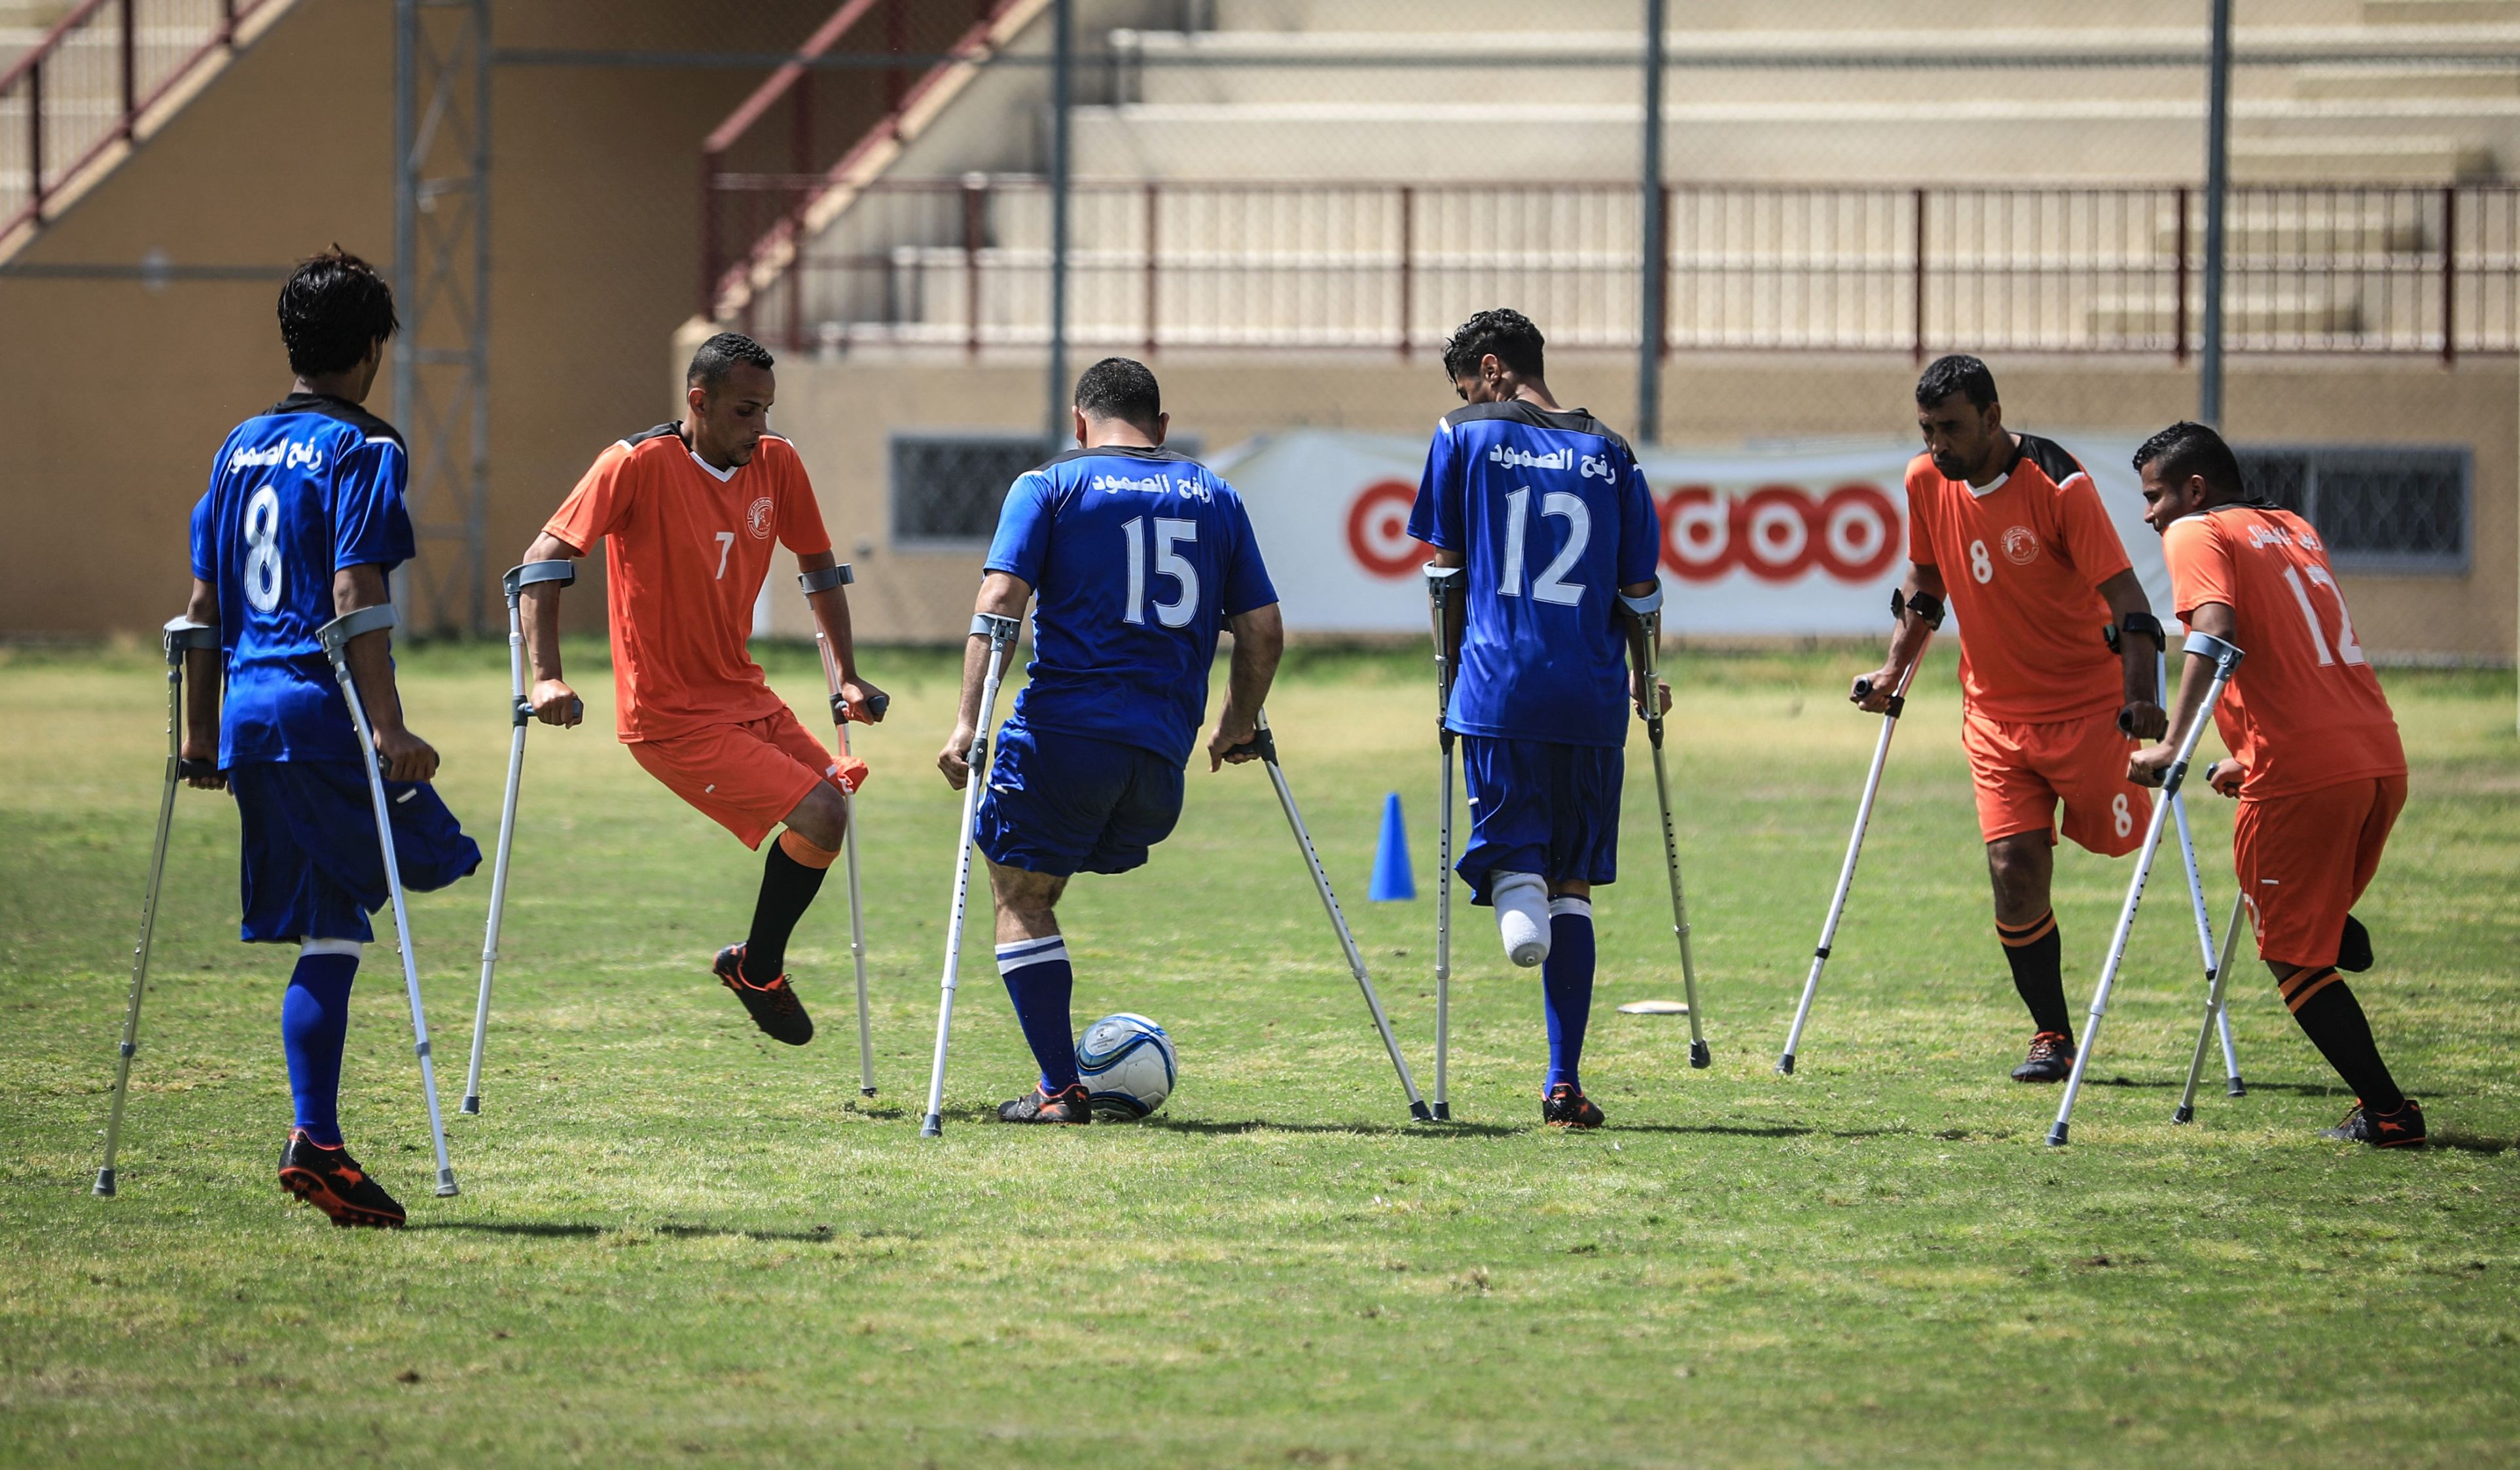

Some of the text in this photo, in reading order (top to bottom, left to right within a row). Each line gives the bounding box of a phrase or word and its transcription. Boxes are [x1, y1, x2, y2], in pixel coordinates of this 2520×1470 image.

[227, 436, 323, 475] رفح الصمو
[1489, 444, 1617, 485] رفح الصمود
[1092, 473, 1211, 503] رفح الصمود
[244, 485, 282, 613] 8
[715, 531, 735, 581] 7
[1497, 486, 1592, 607] 12
[1970, 539, 1993, 584] 8
[1121, 516, 1200, 628] 15
[2283, 564, 2368, 666] 12
[2112, 793, 2133, 838] 8
